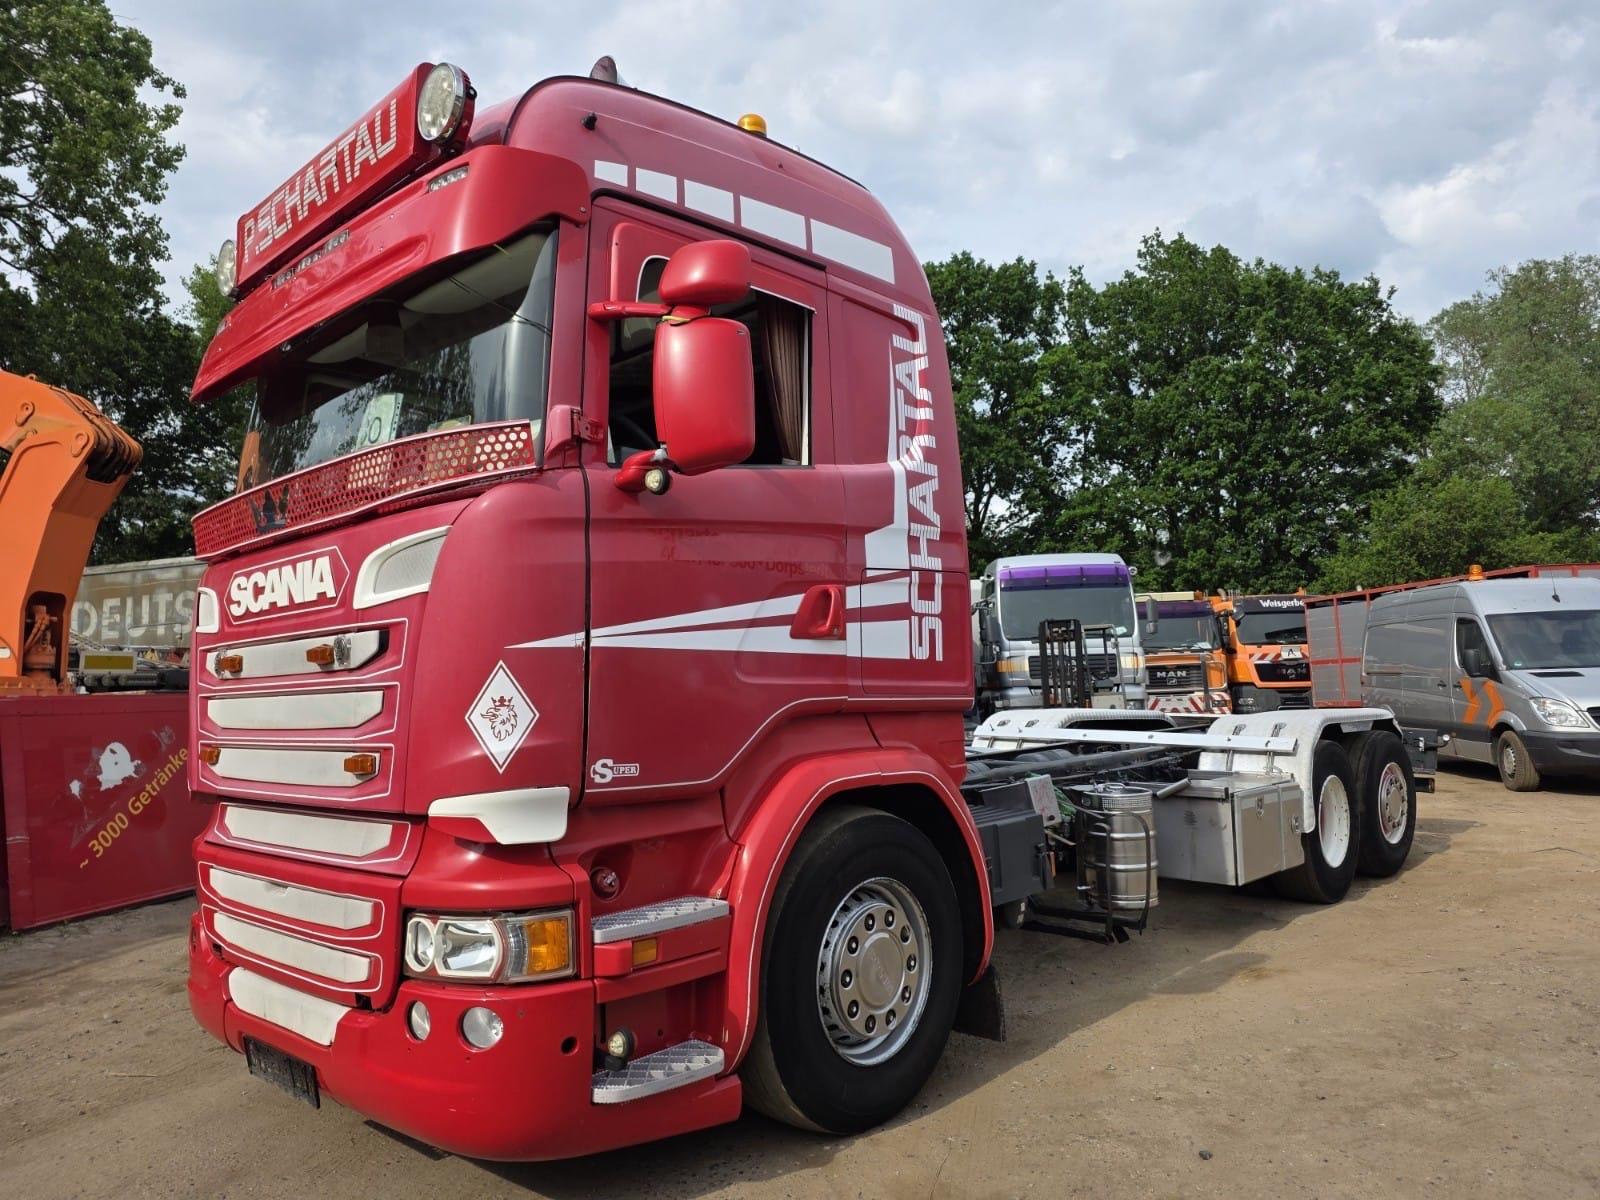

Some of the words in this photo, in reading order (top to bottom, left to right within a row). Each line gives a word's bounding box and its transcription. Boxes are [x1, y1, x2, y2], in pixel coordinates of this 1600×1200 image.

[892, 303, 943, 662] SCHARTAU
[71, 590, 196, 641] DEUTS
[229, 555, 337, 617] SCANIA
[1156, 670, 1187, 678] MAN
[88, 812, 129, 858] 3000
[128, 748, 188, 815] Getränke
